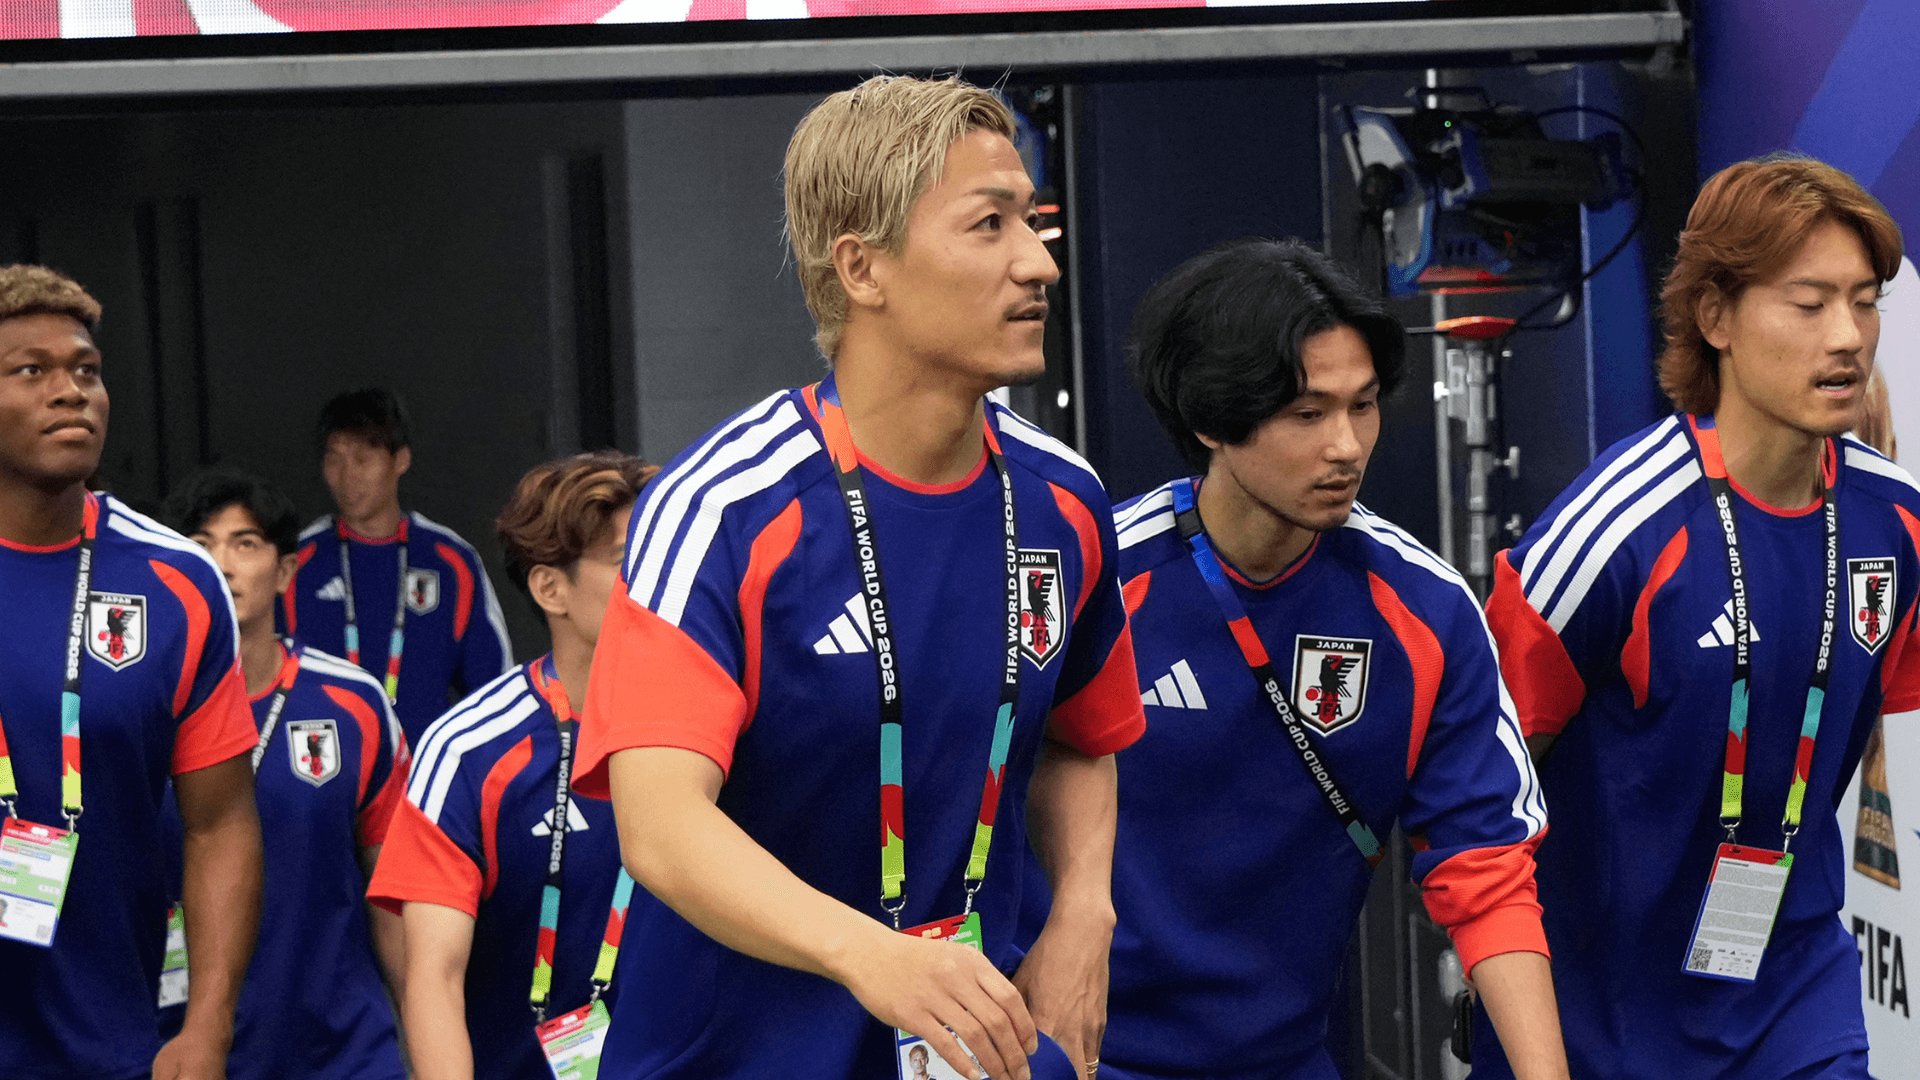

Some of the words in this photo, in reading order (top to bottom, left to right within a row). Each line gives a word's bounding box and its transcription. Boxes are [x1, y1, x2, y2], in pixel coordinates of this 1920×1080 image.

[847, 489, 868, 529] FIFA
[1002, 473, 1015, 536] 2026
[1716, 494, 1737, 546] 2026
[1826, 502, 1836, 533] FIFA
[856, 529, 880, 596] WORLD
[1006, 538, 1017, 575] CUP
[1019, 554, 1047, 564] JAPAN
[1729, 547, 1742, 577] CUP
[1827, 535, 1837, 588] WORLD
[1859, 561, 1885, 571] JAPAN
[75, 572, 89, 612] WORLD
[1008, 577, 1018, 643] WORLD
[1733, 578, 1747, 632] WORLD
[1825, 589, 1836, 619] CUP
[72, 612, 84, 636] CUP
[870, 598, 888, 635] CUP
[1862, 622, 1881, 637] JFA
[1027, 629, 1052, 647] JFA
[1316, 640, 1355, 651] JAPAN
[1737, 632, 1748, 666] FIFA
[1817, 620, 1833, 672] 2026
[67, 636, 80, 680] 2026
[877, 637, 897, 702] 2026
[1006, 645, 1018, 684] FIFA
[1265, 678, 1296, 725] 2026
[1311, 702, 1343, 717] JFA
[1289, 725, 1310, 750] CUP
[556, 759, 569, 804] WORLD
[1303, 750, 1334, 792] WORLD
[555, 804, 566, 830] CUP
[1328, 789, 1350, 815] FIFA
